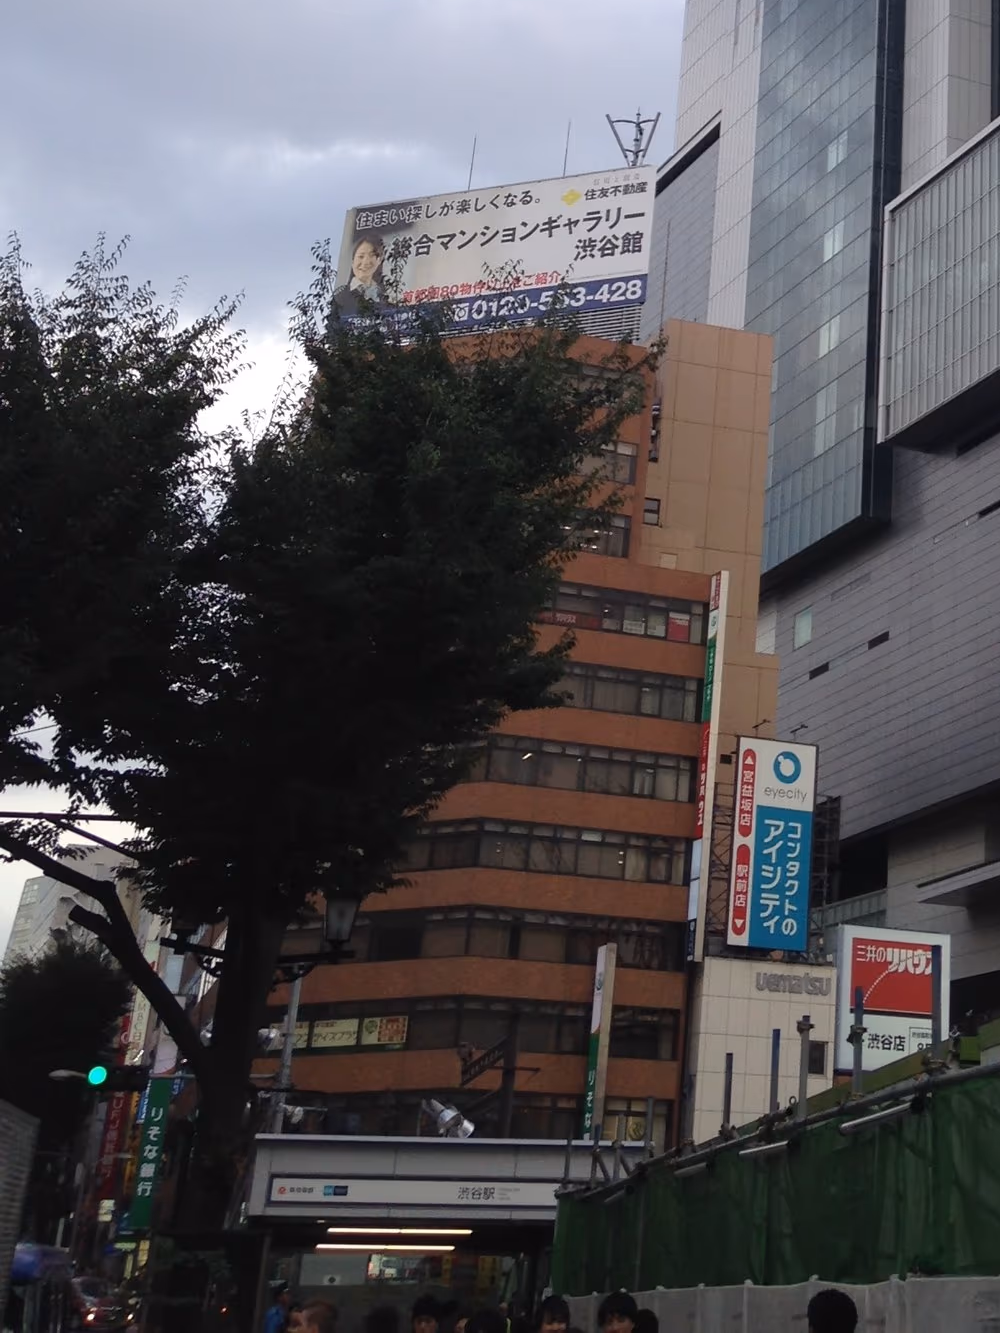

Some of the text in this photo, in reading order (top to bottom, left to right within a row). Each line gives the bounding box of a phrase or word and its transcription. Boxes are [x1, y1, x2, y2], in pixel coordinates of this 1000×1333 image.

[356, 189, 542, 230] 住まい探しが楽しくなる。
[583, 181, 648, 202] 住友不動産
[573, 230, 643, 261] 渋谷館
[740, 769, 754, 827] 宮益坂店
[764, 784, 808, 803] eyecity
[734, 865, 749, 907] 駅前店
[759, 819, 785, 934] アイシティ
[781, 822, 802, 937] コンタクトの
[755, 970, 832, 997] uematsu
[867, 1032, 906, 1052] 渋谷店
[136, 1106, 164, 1197] りそな銀行
[457, 1186, 496, 1201] 渋谷駅
